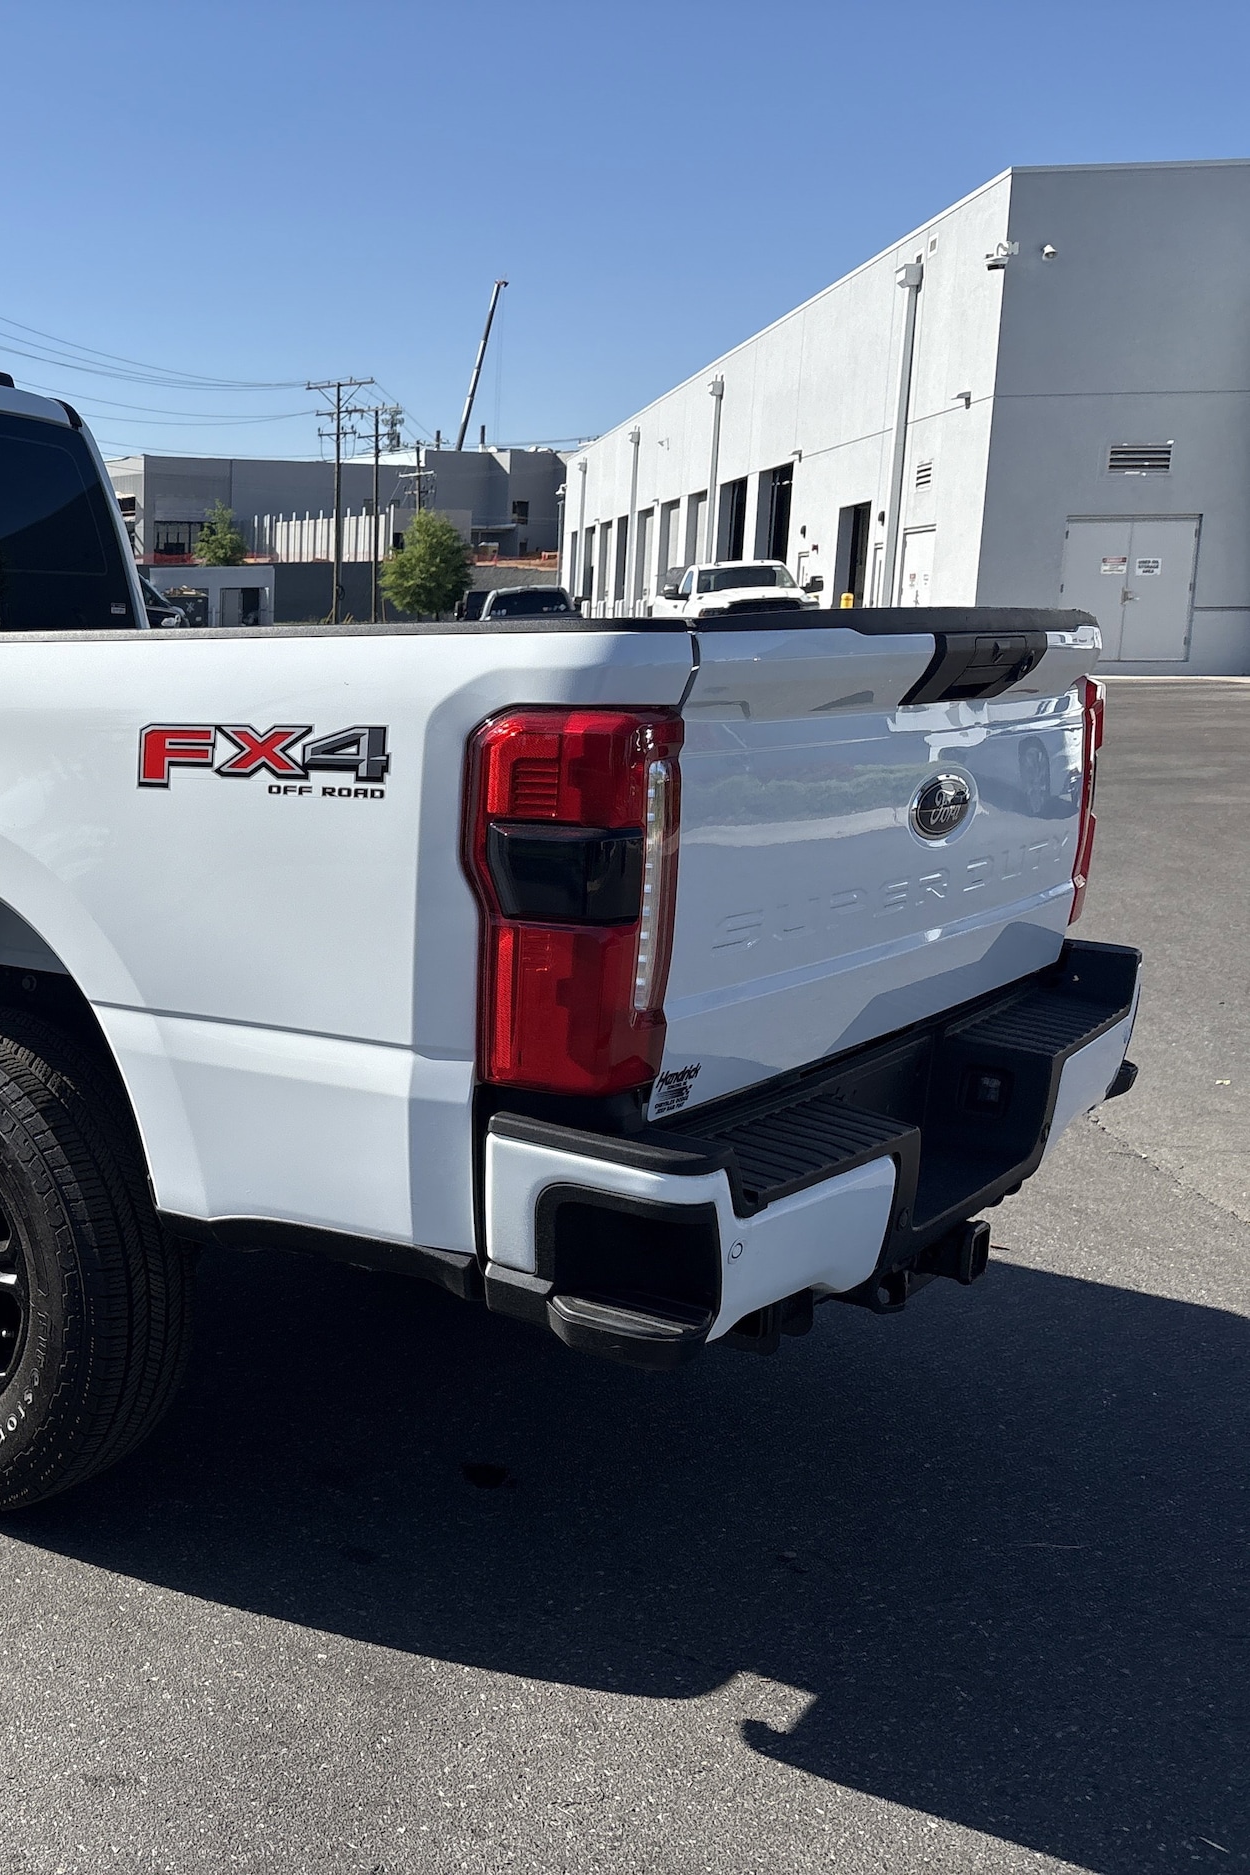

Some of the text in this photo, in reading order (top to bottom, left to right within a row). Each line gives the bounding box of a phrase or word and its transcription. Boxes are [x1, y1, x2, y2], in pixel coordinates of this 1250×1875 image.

[137, 722, 391, 790] FX4
[267, 784, 386, 799] OFF ROAD
[963, 830, 1071, 894] DUTY
[655, 1062, 702, 1092] Hendrick
